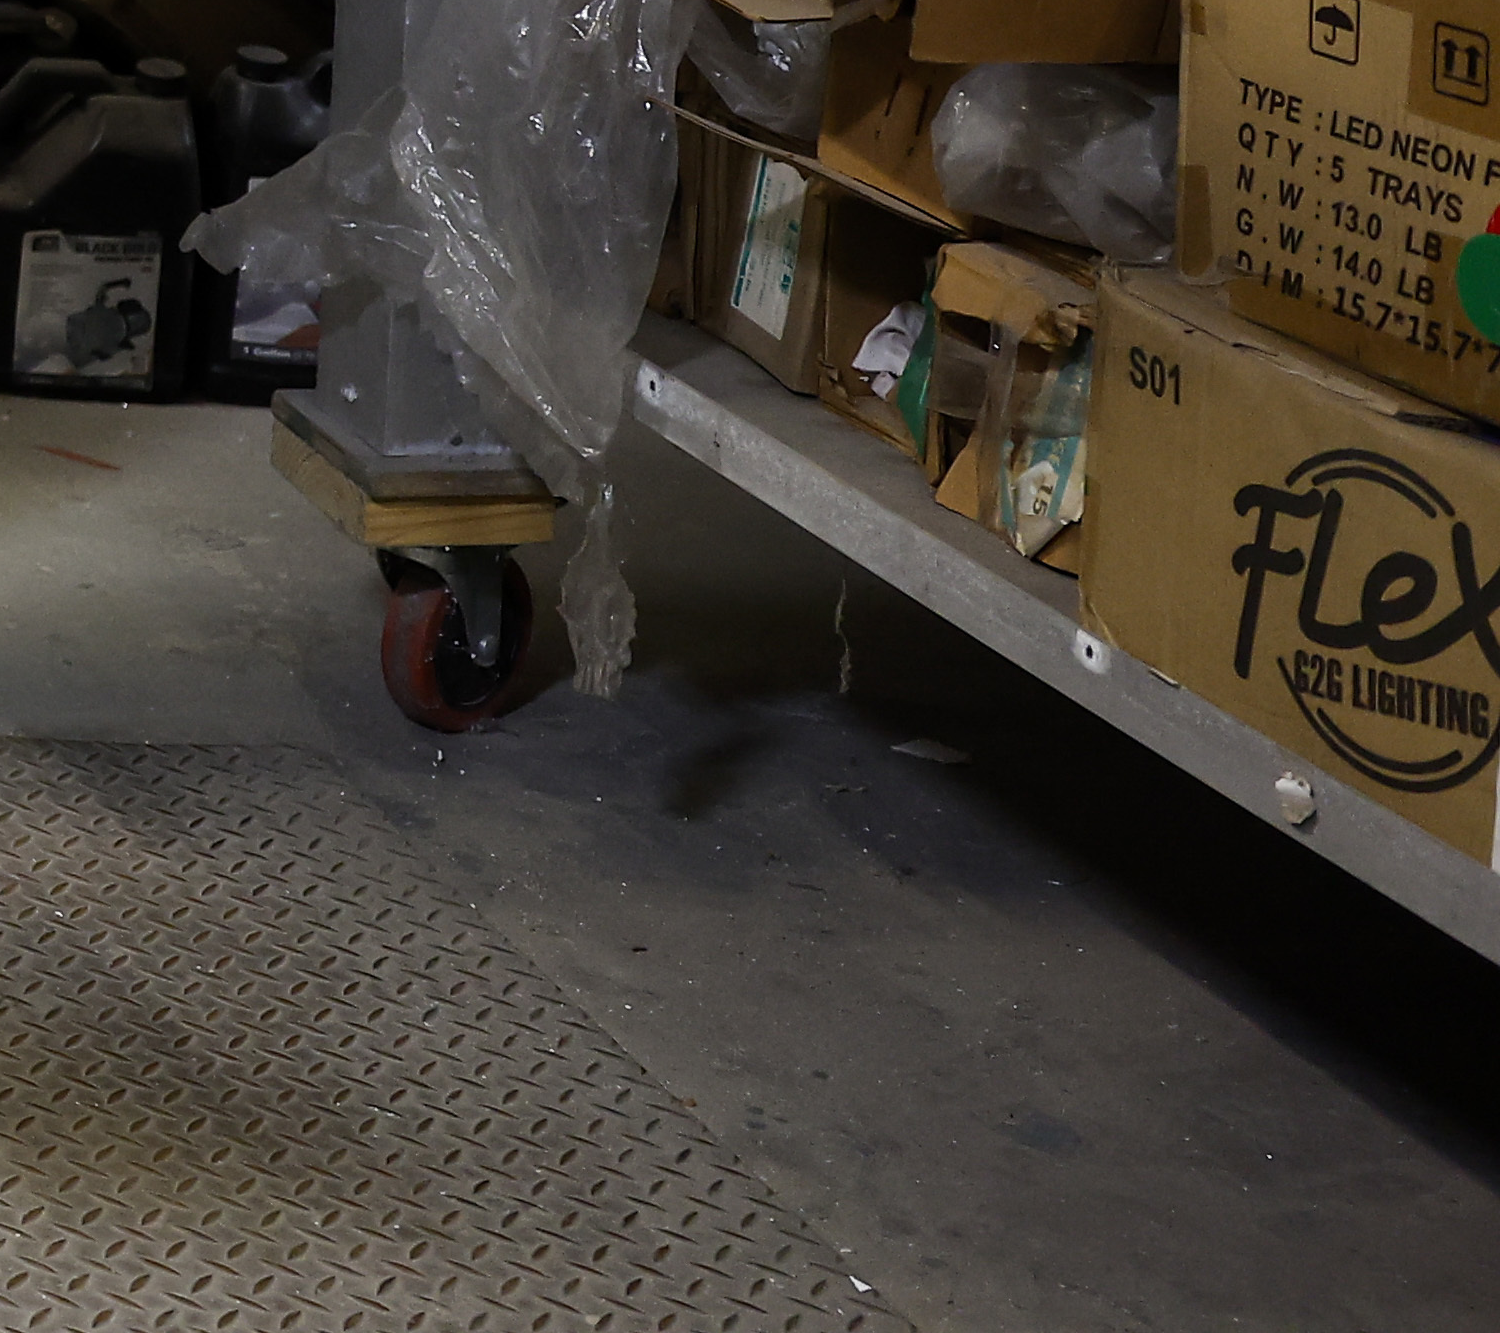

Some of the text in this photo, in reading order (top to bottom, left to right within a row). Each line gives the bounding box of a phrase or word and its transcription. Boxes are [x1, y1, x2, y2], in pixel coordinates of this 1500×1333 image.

[1238, 76, 1304, 125] TYPE
[1329, 108, 1384, 153] LED
[1390, 128, 1478, 184] NEON
[1330, 155, 1345, 184] 5
[1366, 165, 1464, 224] TRAYS
[1331, 200, 1383, 242] 13.0
[1404, 226, 1443, 263] LB
[1332, 245, 1383, 286] 14.0
[1397, 268, 1436, 306] LB
[1129, 345, 1182, 406] S01
[1351, 663, 1492, 741] LIGHTING
